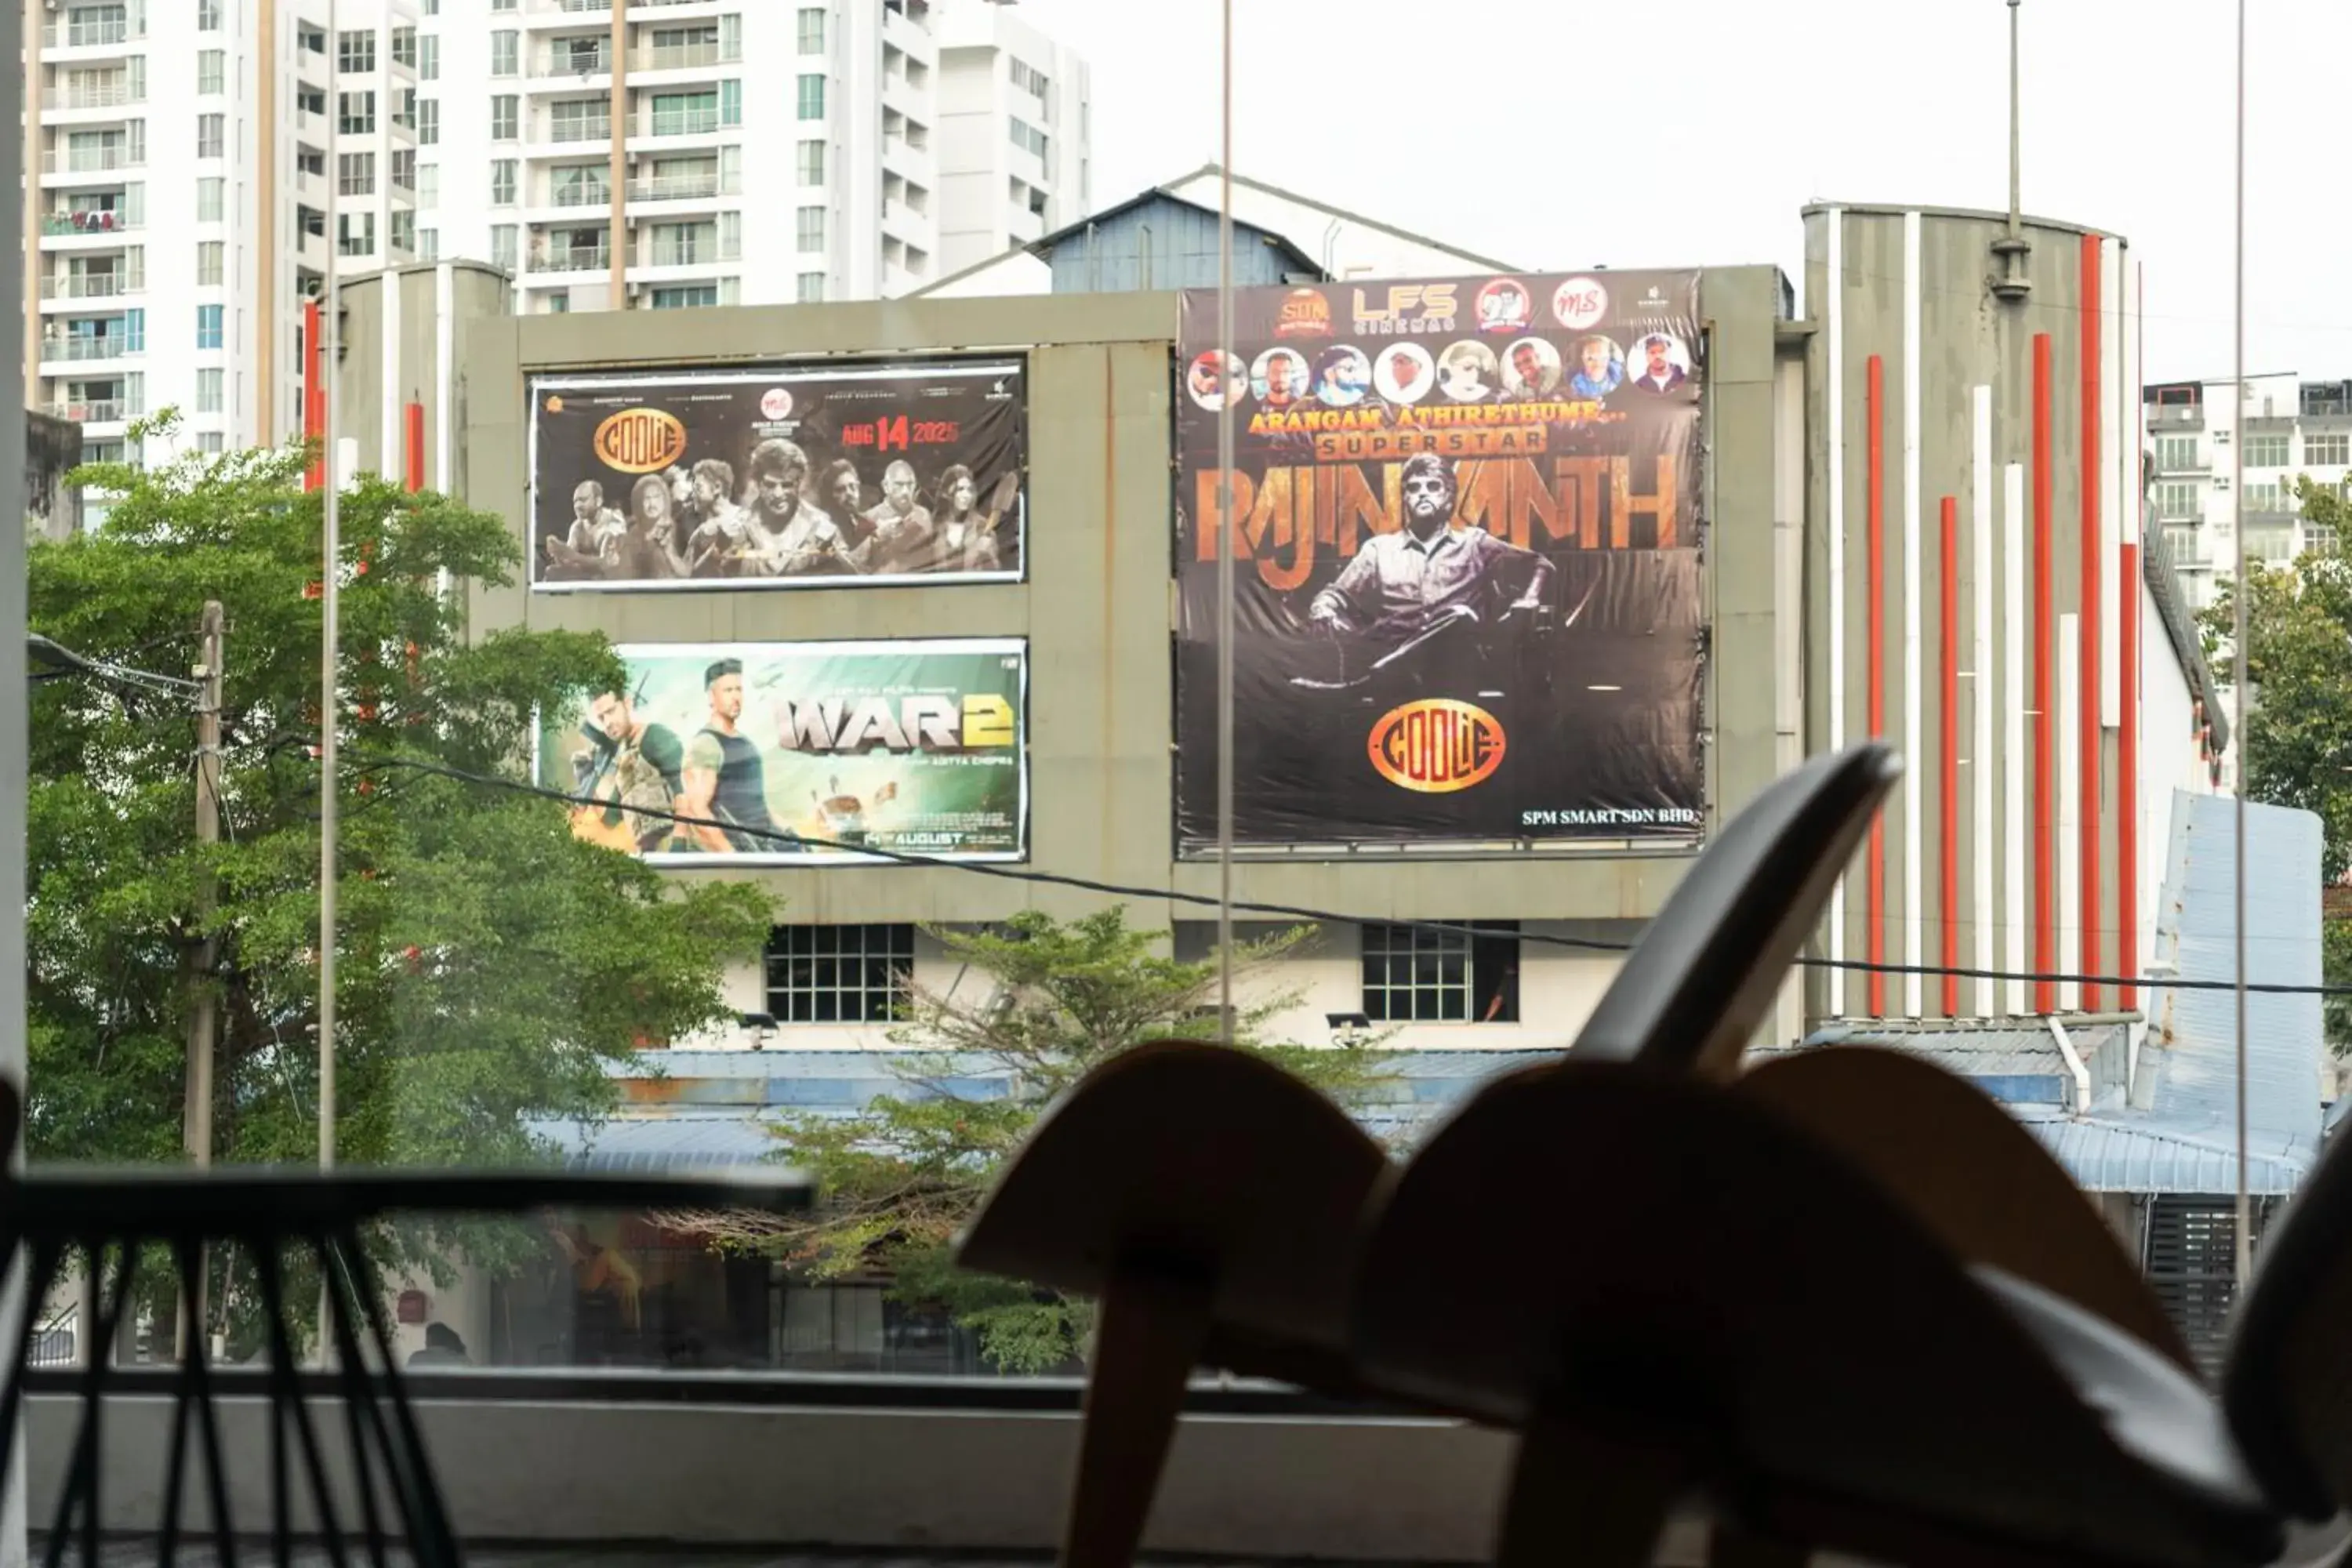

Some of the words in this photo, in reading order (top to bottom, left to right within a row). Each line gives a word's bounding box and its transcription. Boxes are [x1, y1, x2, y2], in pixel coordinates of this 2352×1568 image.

[1352, 284, 1457, 321] LFS
[1353, 318, 1455, 336] CINEMAS
[842, 423, 874, 445] AUG
[877, 415, 909, 452] 14
[913, 422, 960, 443] 2025
[1248, 408, 1382, 433] ARANGAM
[1321, 430, 1541, 456] SUPERSTAR
[1196, 454, 1677, 591] RAJINANTH
[775, 694, 961, 753] WAR
[963, 693, 1014, 747] 2
[1381, 708, 1494, 782] COOLIE
[1522, 810, 1557, 825] SPM
[1559, 809, 1618, 824] SMART
[1621, 808, 1655, 823] SDN
[895, 832, 964, 845] AUGUST
